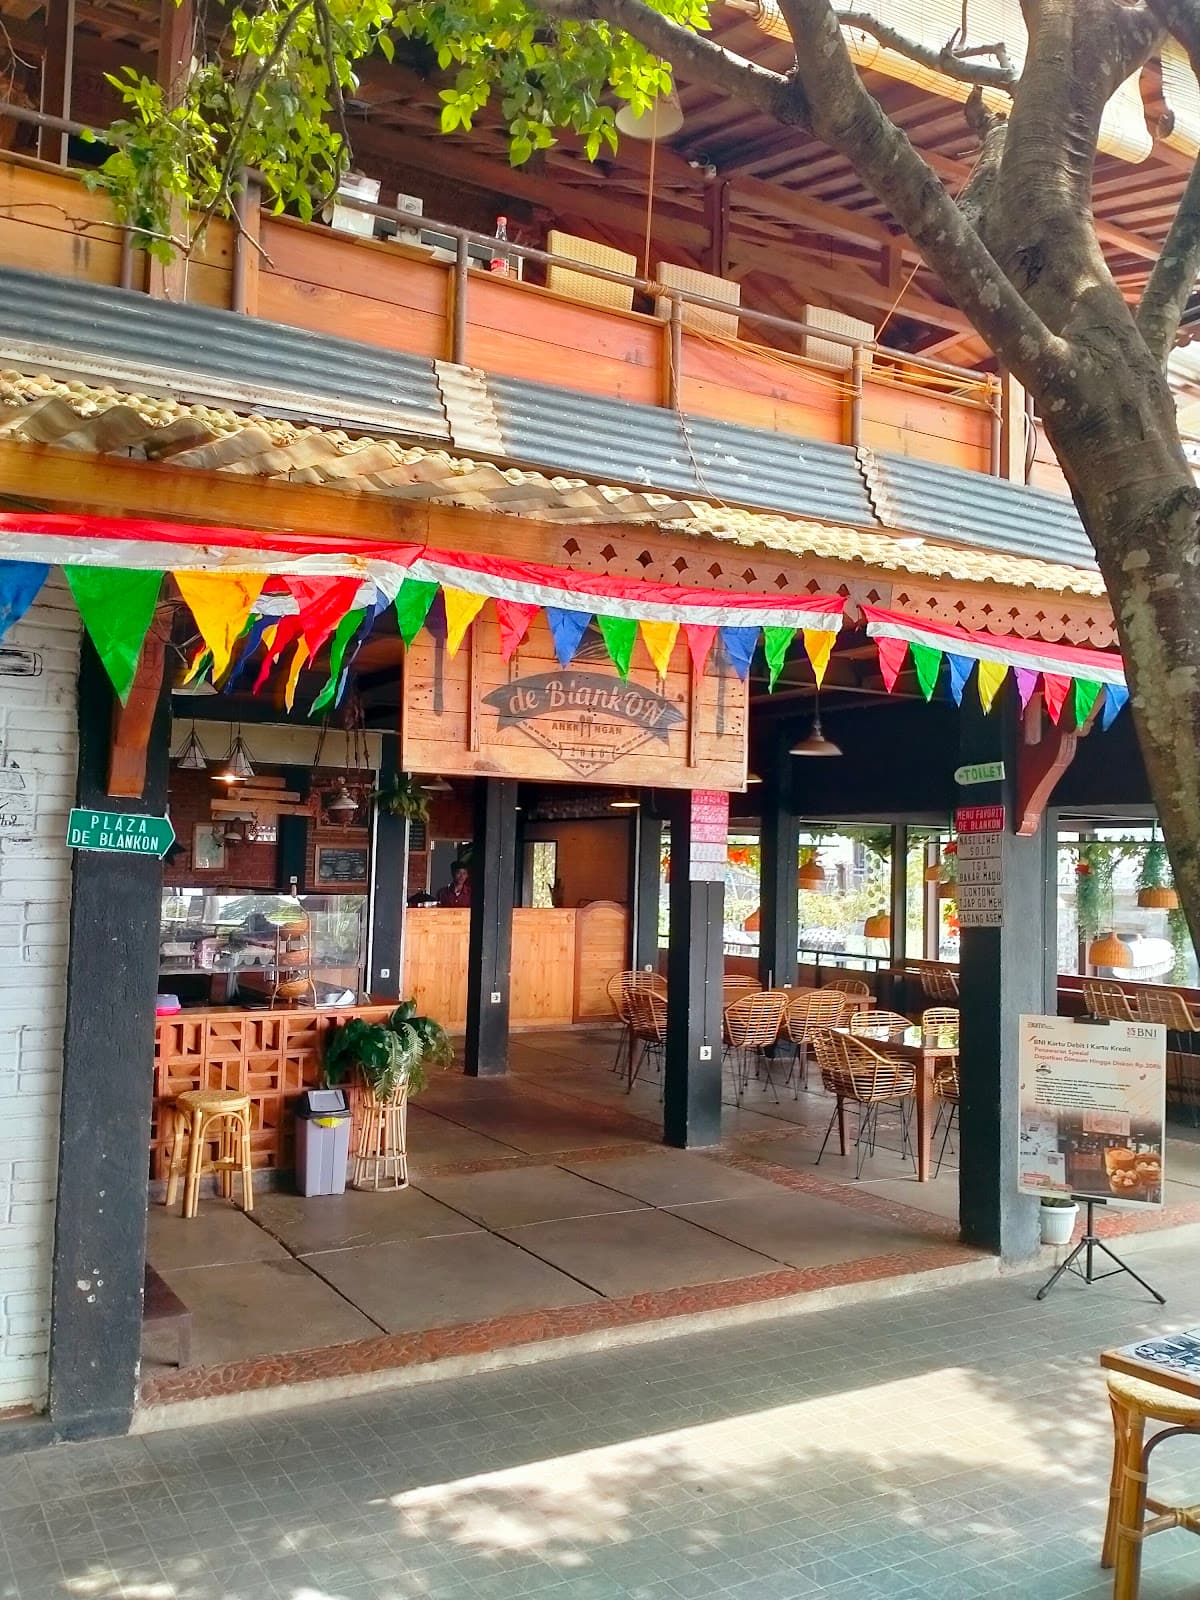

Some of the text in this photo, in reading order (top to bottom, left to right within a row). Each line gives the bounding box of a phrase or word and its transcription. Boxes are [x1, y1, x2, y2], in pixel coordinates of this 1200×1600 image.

[509, 687, 539, 714] de
[963, 766, 1002, 781] TOILET
[957, 807, 1003, 820] MENU FAVORIT
[91, 815, 147, 834] PLAZA
[958, 819, 1001, 831] DE BLANKON
[71, 828, 159, 851] DE BLANKON
[960, 836, 976, 845] NASI
[970, 845, 991, 856] SOLO
[983, 871, 1001, 881] MADU
[964, 886, 995, 897] LONTONG
[977, 899, 986, 908] GO
[990, 899, 1002, 908] MEH
[1137, 1027, 1157, 1038] BNI
[1091, 1043, 1109, 1051] Kartu
[1068, 1049, 1089, 1057] Spesial
[1034, 1053, 1063, 1062] Dapatkan
[1090, 1058, 1111, 1066] Hingga
